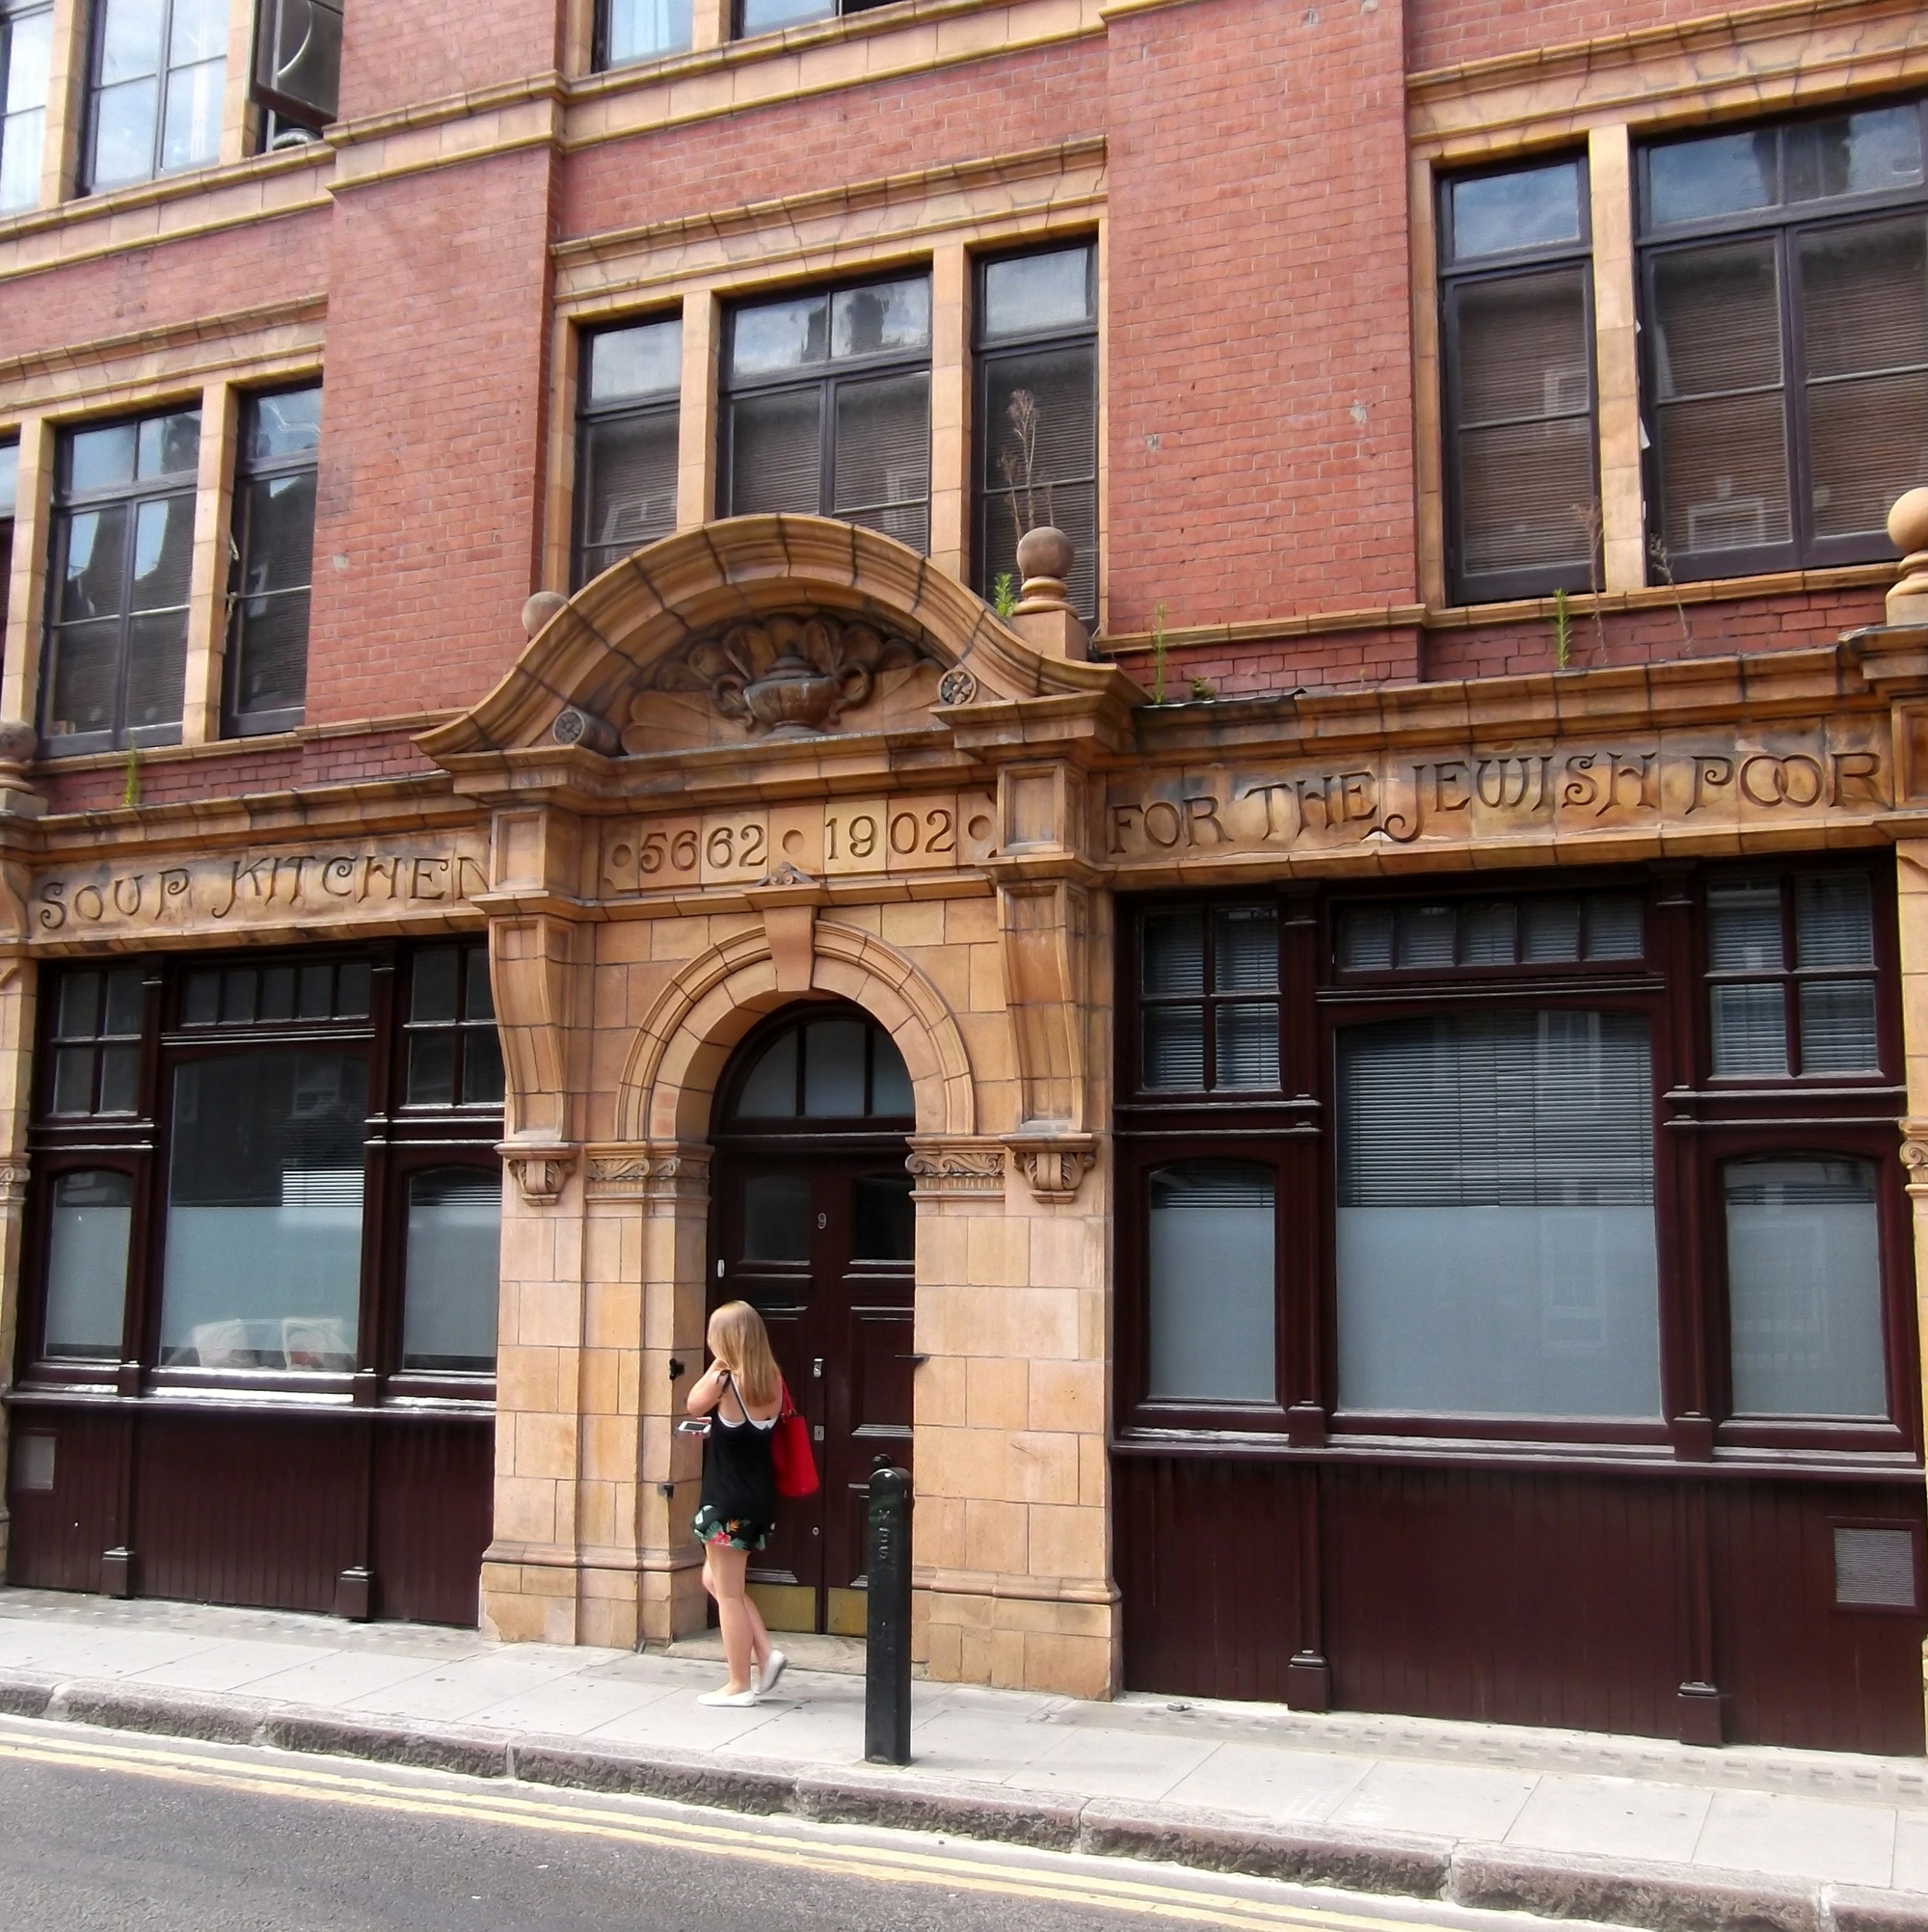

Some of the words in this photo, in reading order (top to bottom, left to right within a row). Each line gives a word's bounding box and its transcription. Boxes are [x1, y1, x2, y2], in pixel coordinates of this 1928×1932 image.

[1110, 794, 1234, 854] FOR
[1244, 770, 1379, 841] THE
[1360, 751, 1659, 843] JEWISH
[1684, 751, 1893, 816] POOR
[640, 824, 767, 874] 5662
[825, 809, 955, 861] 1902
[39, 867, 191, 930] SOUP
[817, 1212, 827, 1229] 9
